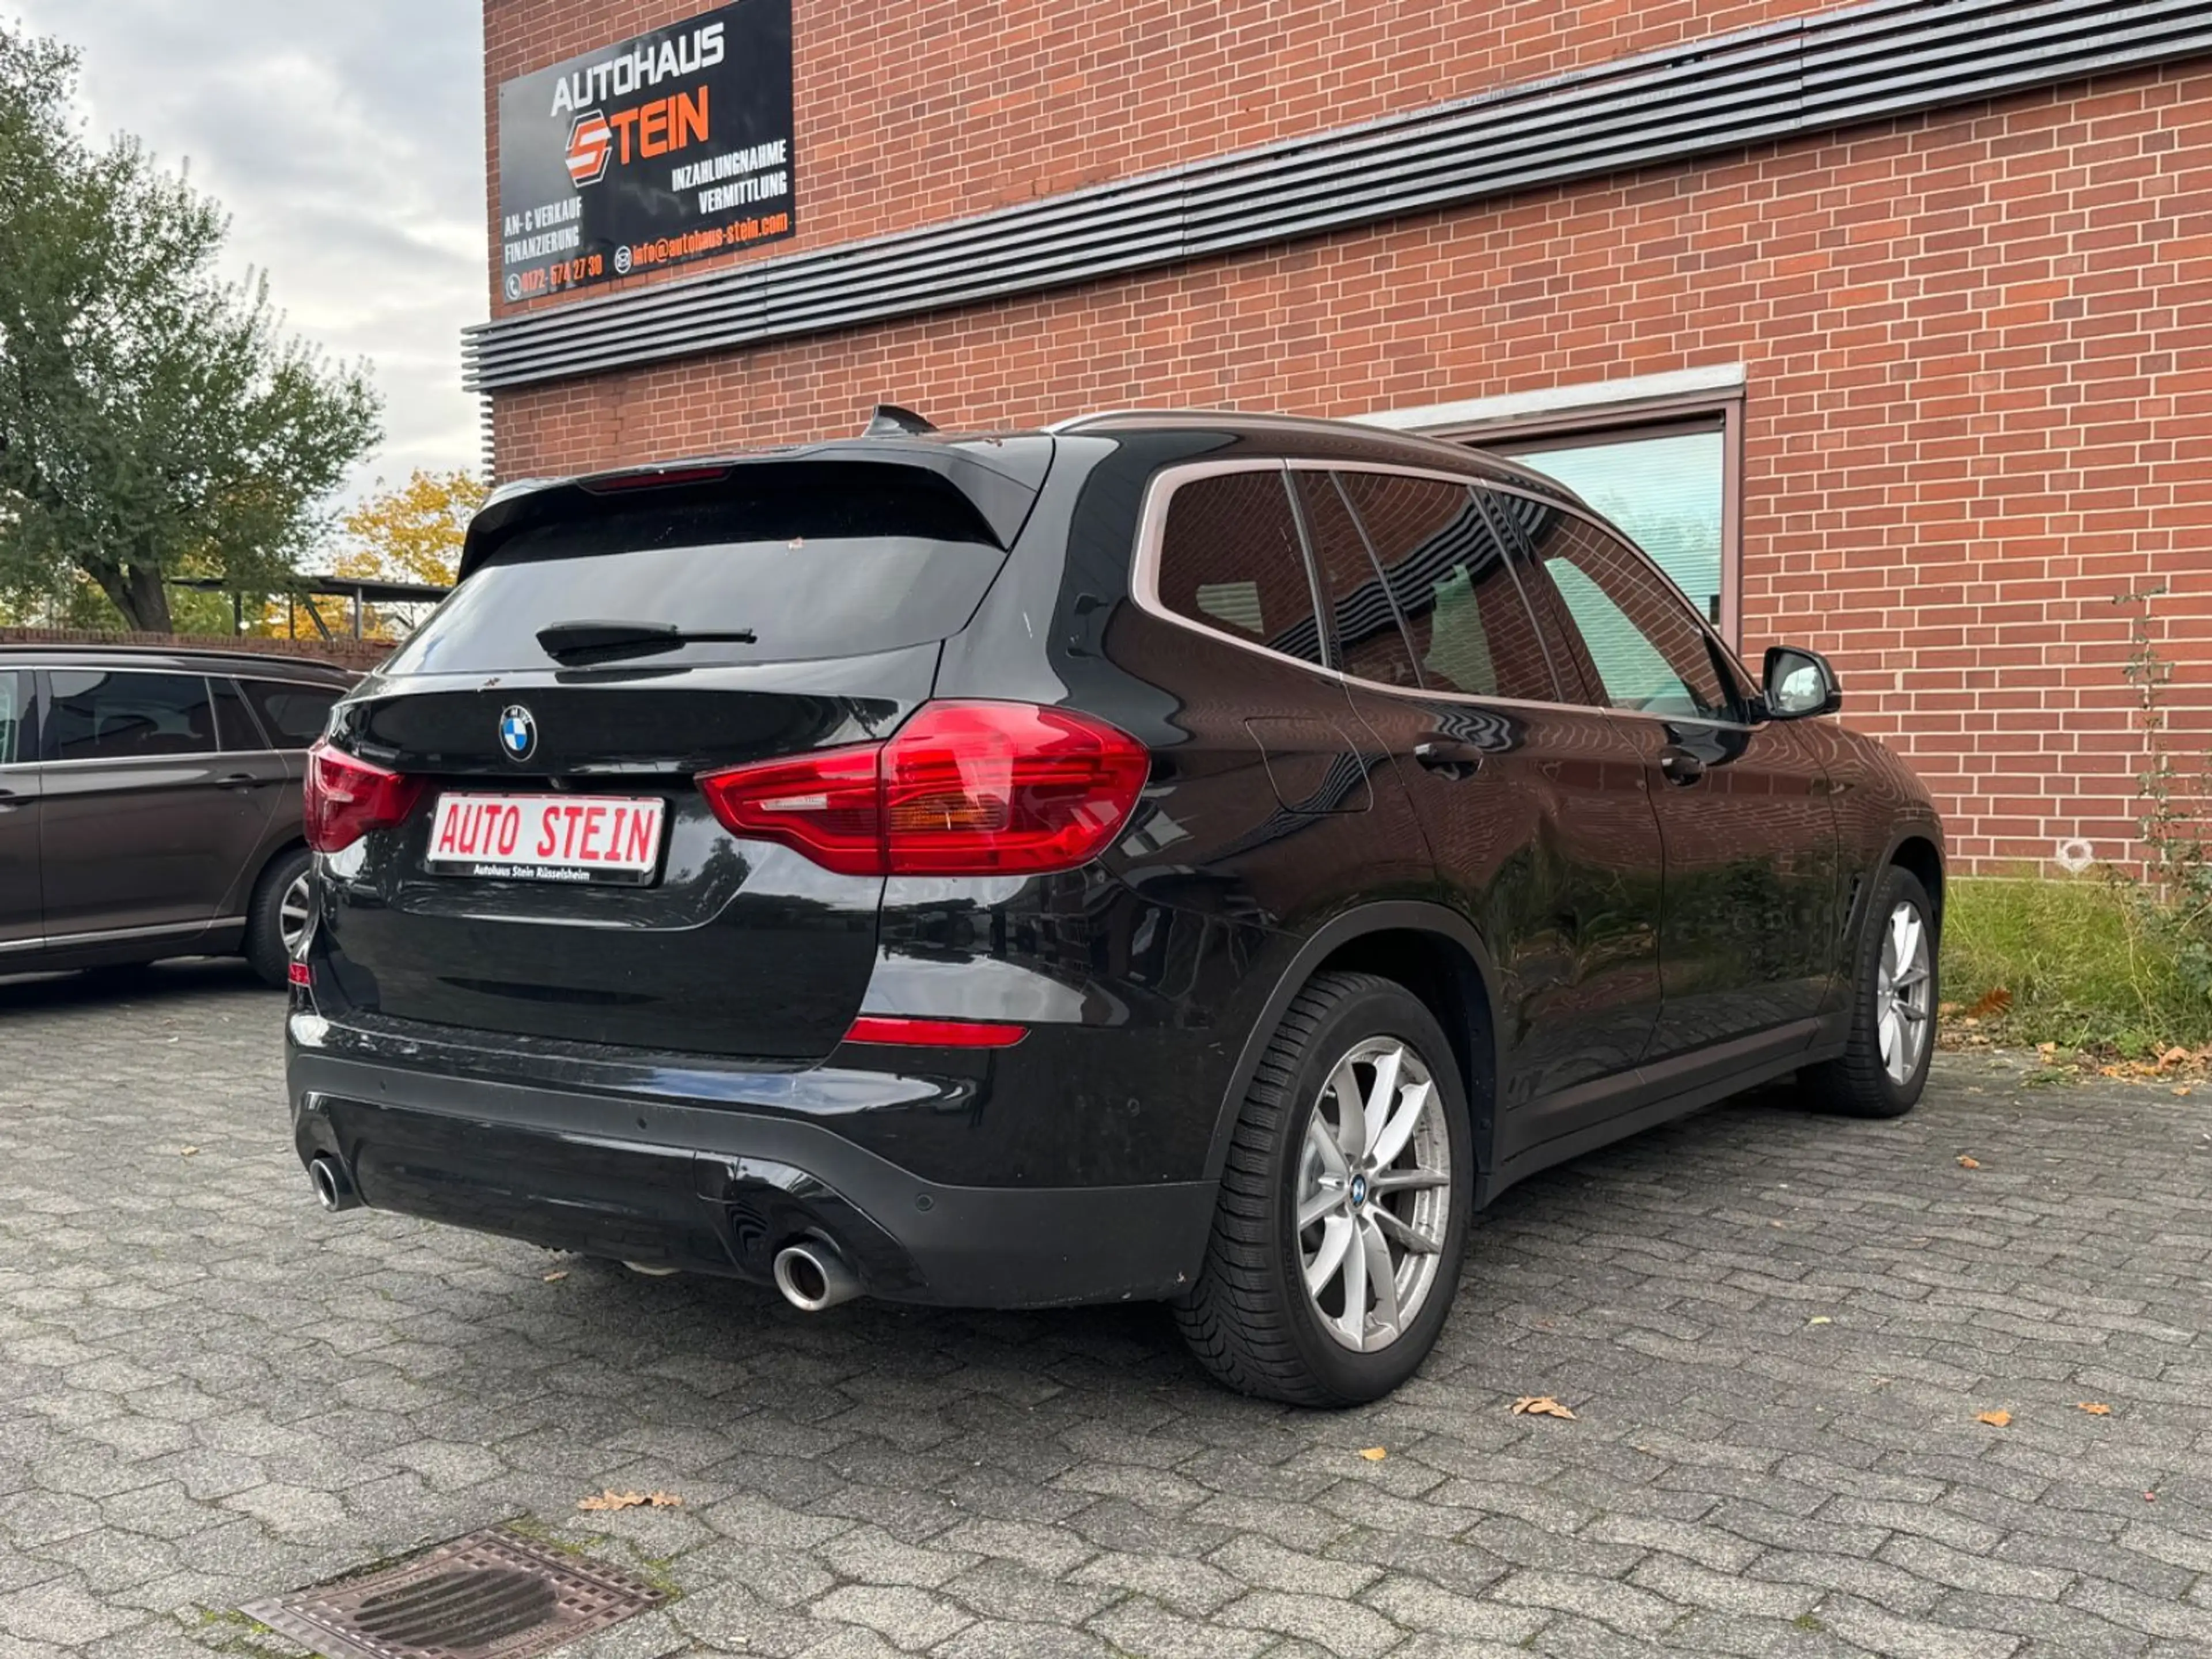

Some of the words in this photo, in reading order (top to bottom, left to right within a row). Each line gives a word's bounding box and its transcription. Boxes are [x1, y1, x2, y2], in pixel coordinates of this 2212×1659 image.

[550, 22, 724, 117] AUTOHAUS
[565, 85, 709, 188] STEIN
[672, 139, 787, 192] INZAHLUNGNAHME
[534, 196, 582, 229] VERKAUF
[698, 171, 787, 214] VERMITTLUNG
[505, 226, 579, 265] FINANZIERUNG
[632, 212, 788, 266] info@autohaus-stein.com
[573, 257, 586, 280] 27
[438, 804, 520, 855] AUTO
[537, 806, 654, 863] STEIN
[474, 864, 510, 876] Autohaus
[512, 865, 535, 877] Stein
[536, 866, 590, 881] Rüsselsheim
